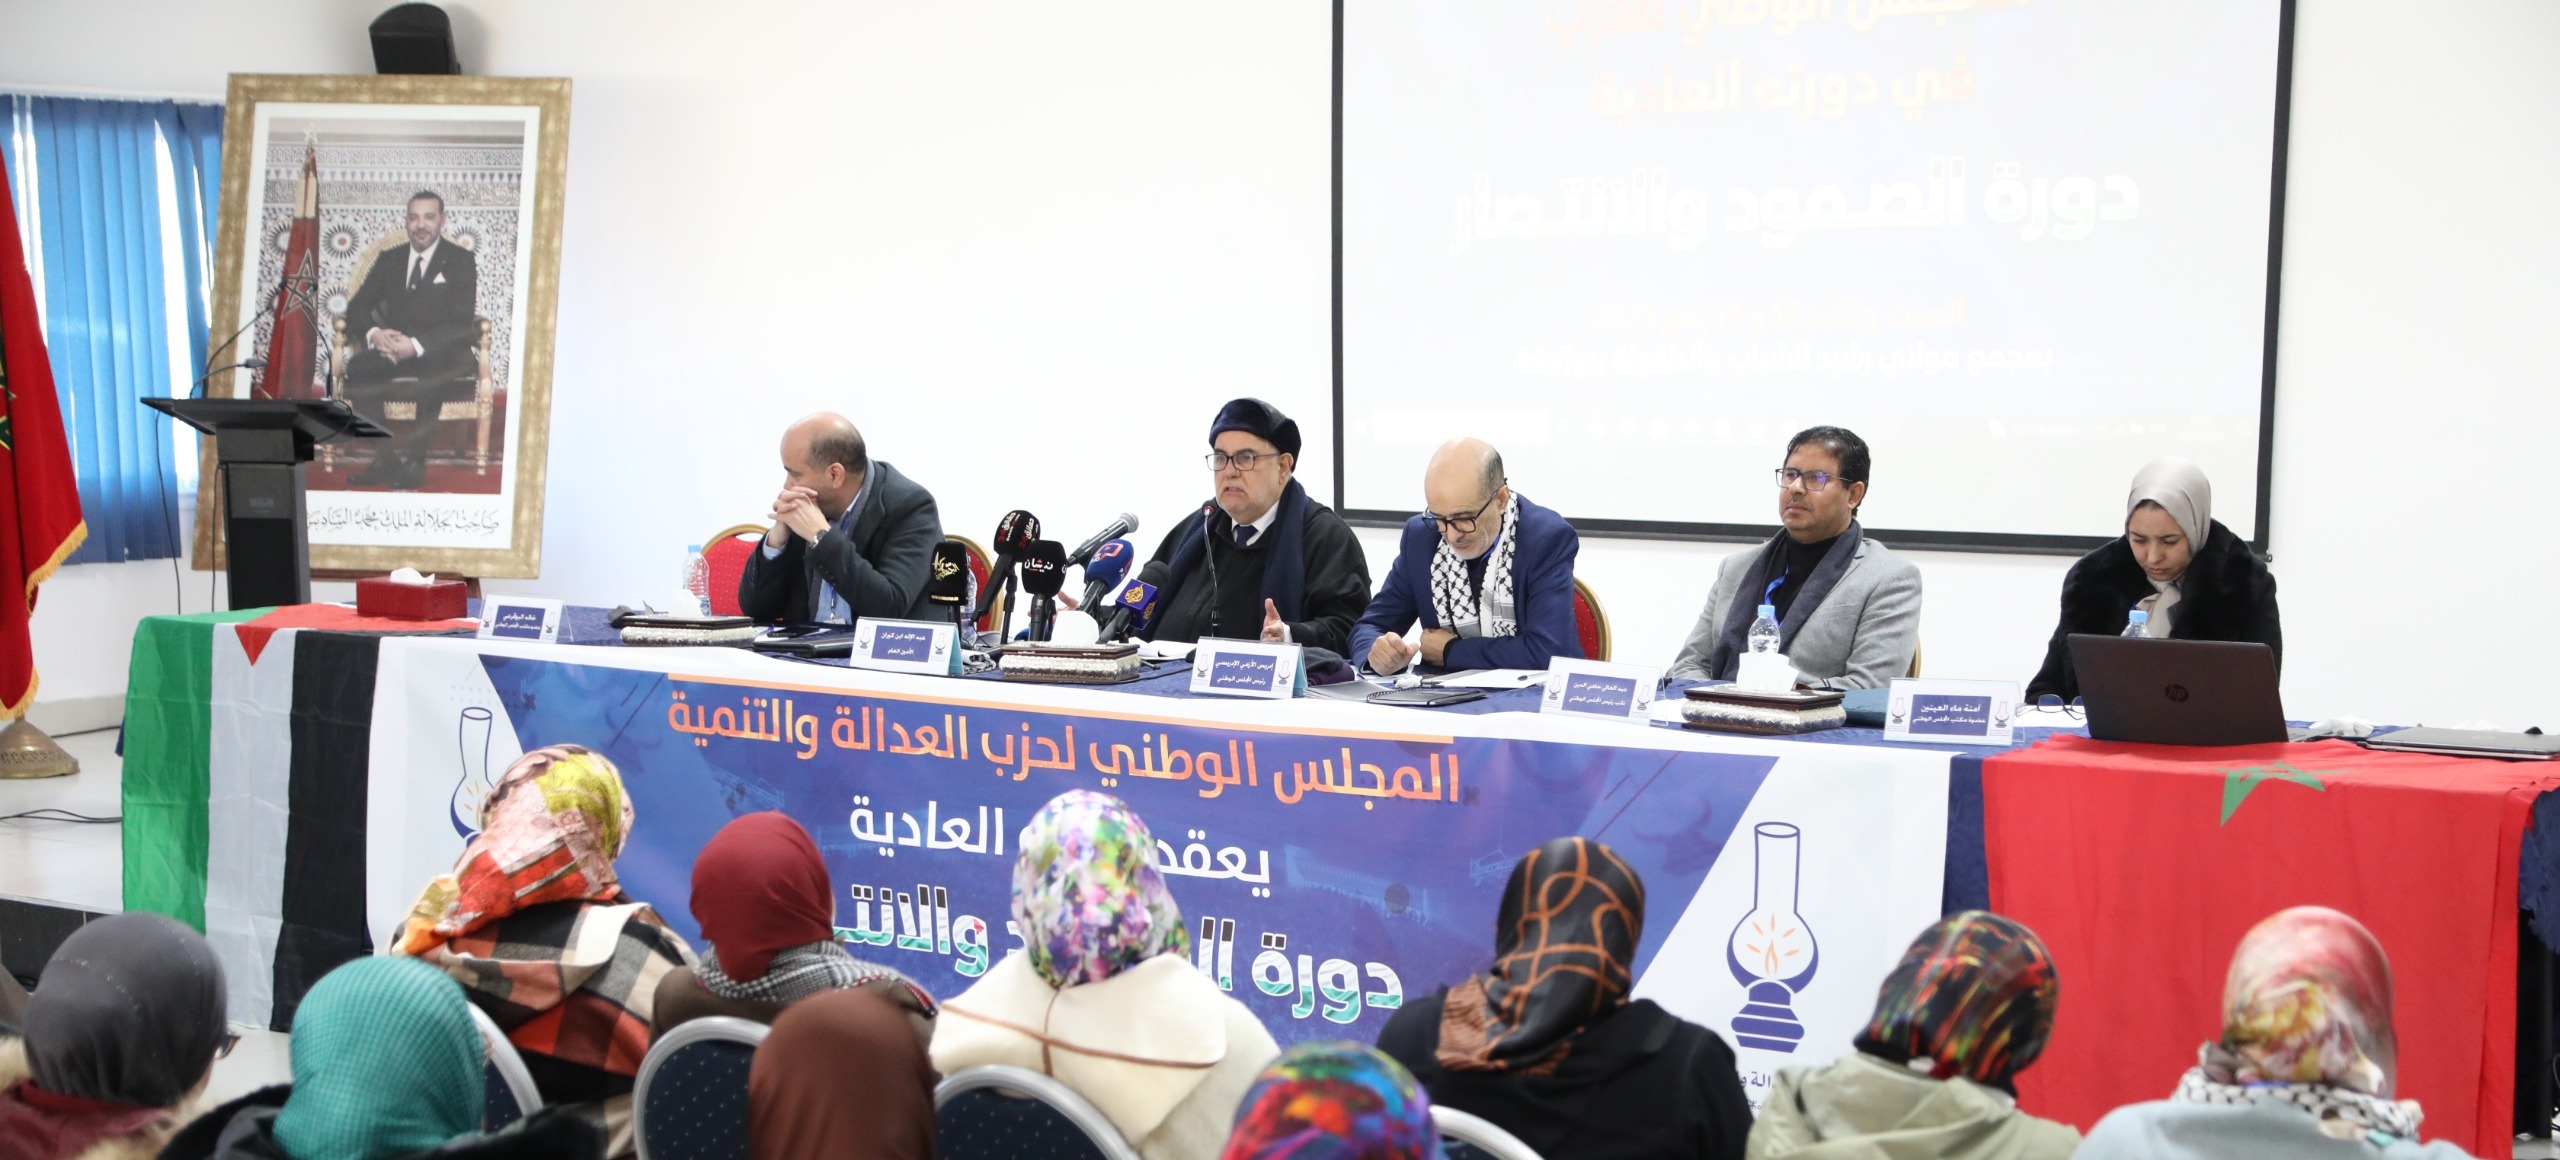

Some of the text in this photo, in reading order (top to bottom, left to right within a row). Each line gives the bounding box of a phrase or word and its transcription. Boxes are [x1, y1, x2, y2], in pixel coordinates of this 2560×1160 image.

[1591, 51, 1977, 129] في دورته العادية
[1449, 155, 2141, 255] دورة الصمود والانتصار
[1727, 341, 1811, 377] للشباب
[1817, 337, 1872, 378] رشيد
[1879, 340, 1959, 379] مولاي
[1967, 349, 2053, 376] بمجمع
[1024, 557, 1054, 573] نيشان
[1215, 660, 1239, 668] الإدريسي
[1217, 675, 1235, 683] الوطني
[1240, 659, 1256, 670] الأزمي
[1601, 684, 1618, 692] العالي
[1921, 704, 1948, 712] العينين
[1933, 715, 1949, 723] المجلس
[1963, 704, 1980, 712] آمنة
[668, 690, 1459, 811] المجلس الوطني لحزب العدالة والتنمية
[850, 795, 1271, 898] يعقد العادية
[833, 883, 989, 978] والانت
[1251, 931, 1403, 1025] دورة
